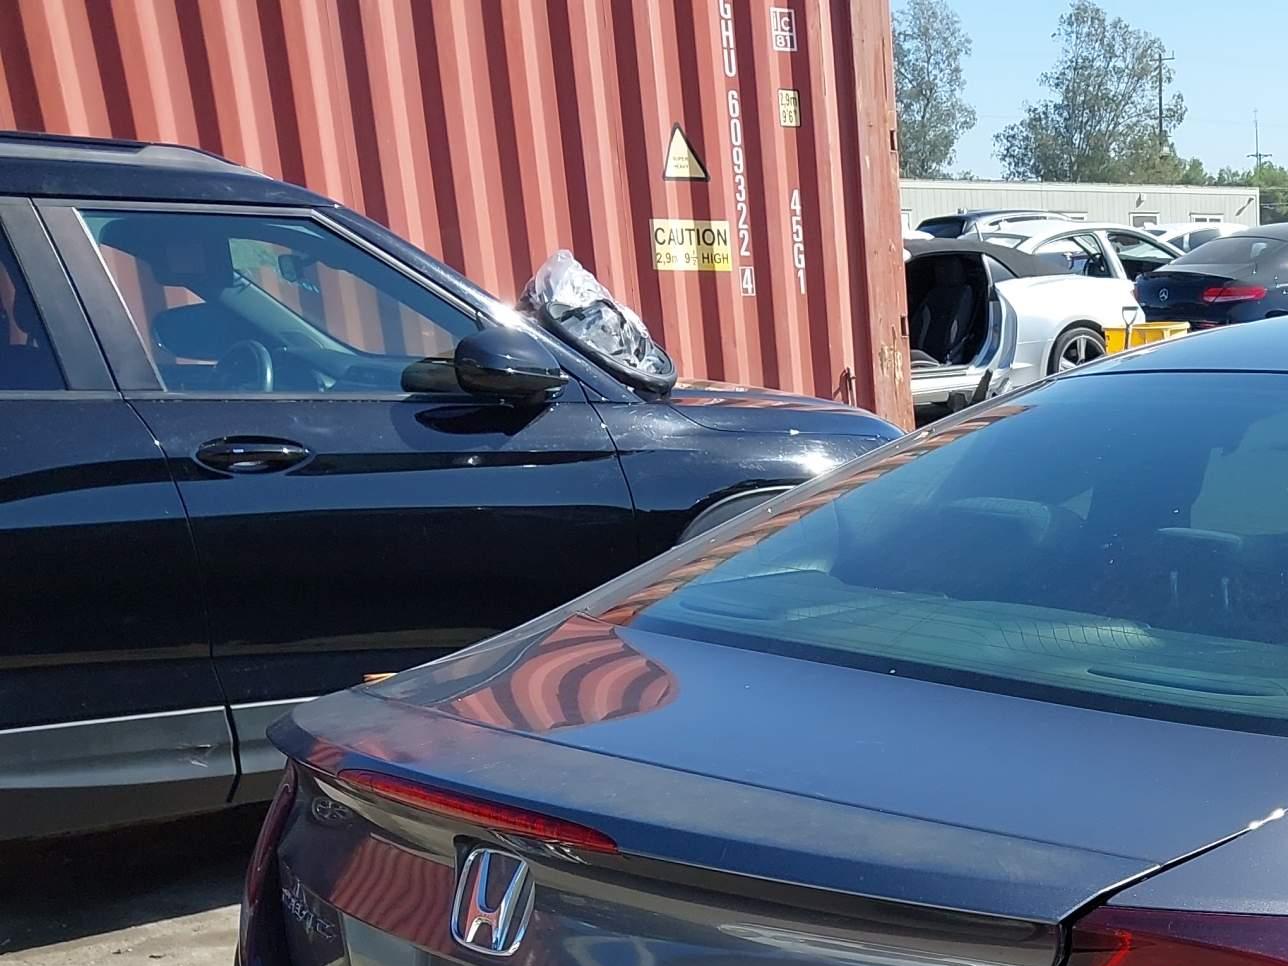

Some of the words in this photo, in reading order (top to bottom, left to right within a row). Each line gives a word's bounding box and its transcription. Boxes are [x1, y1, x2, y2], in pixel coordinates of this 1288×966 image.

[728, 90, 750, 257] 609322
[654, 227, 728, 247] CAUTION
[701, 253, 729, 265] HIGH
[790, 188, 806, 295] 45G1
